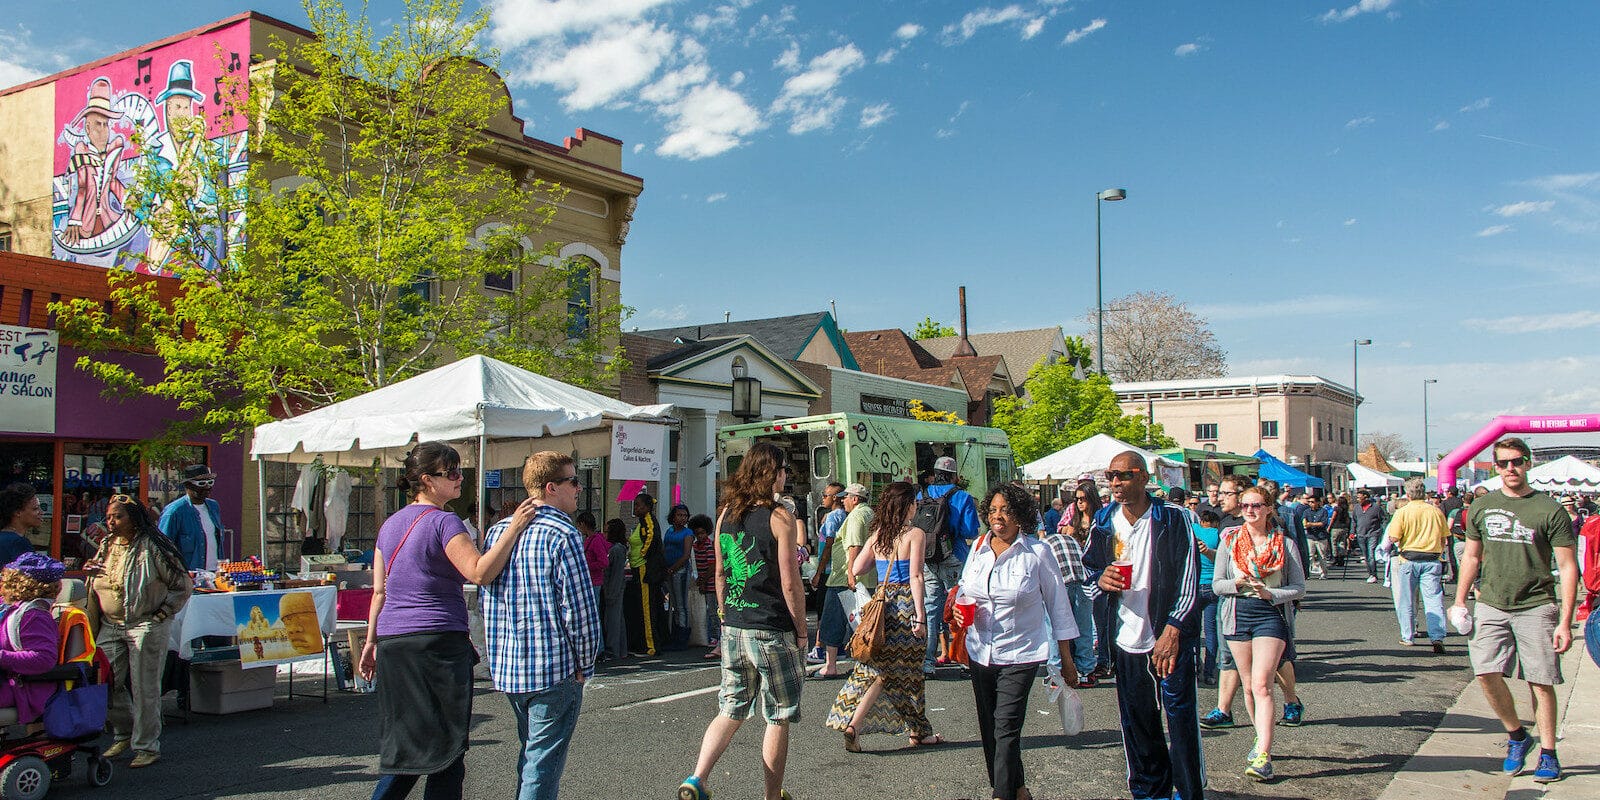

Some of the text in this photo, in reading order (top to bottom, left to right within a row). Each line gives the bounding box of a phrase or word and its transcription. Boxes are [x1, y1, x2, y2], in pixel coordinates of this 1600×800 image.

[12, 384, 52, 398] SALON
[1546, 419, 1568, 428] BEVERAGE
[1569, 418, 1587, 427] MARKET
